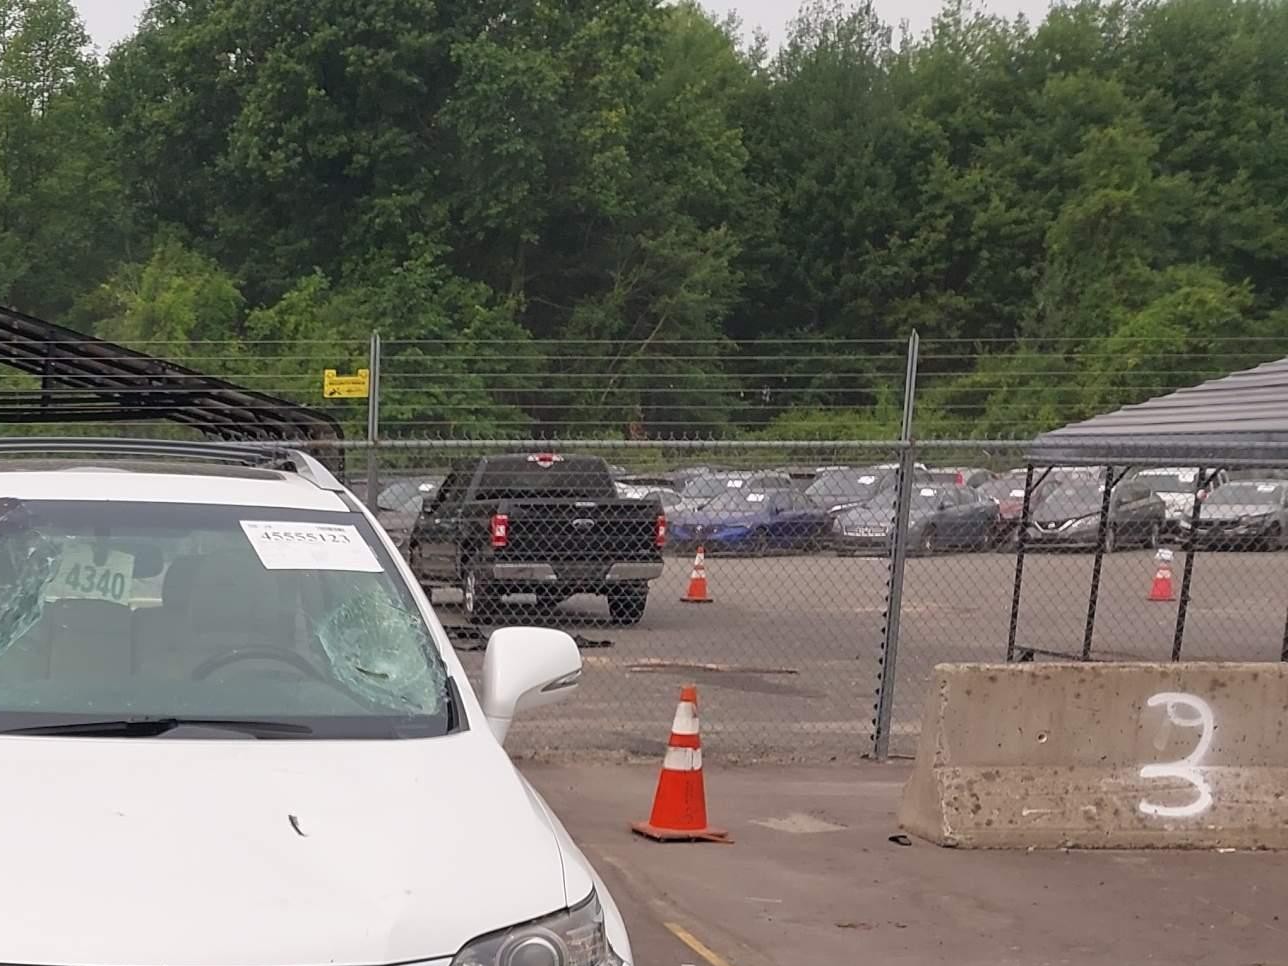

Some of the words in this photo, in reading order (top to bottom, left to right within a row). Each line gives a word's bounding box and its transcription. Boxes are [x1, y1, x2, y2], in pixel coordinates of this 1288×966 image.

[261, 531, 352, 544] 45555123
[65, 563, 125, 600] 4340
[1139, 692, 1213, 816] 3
